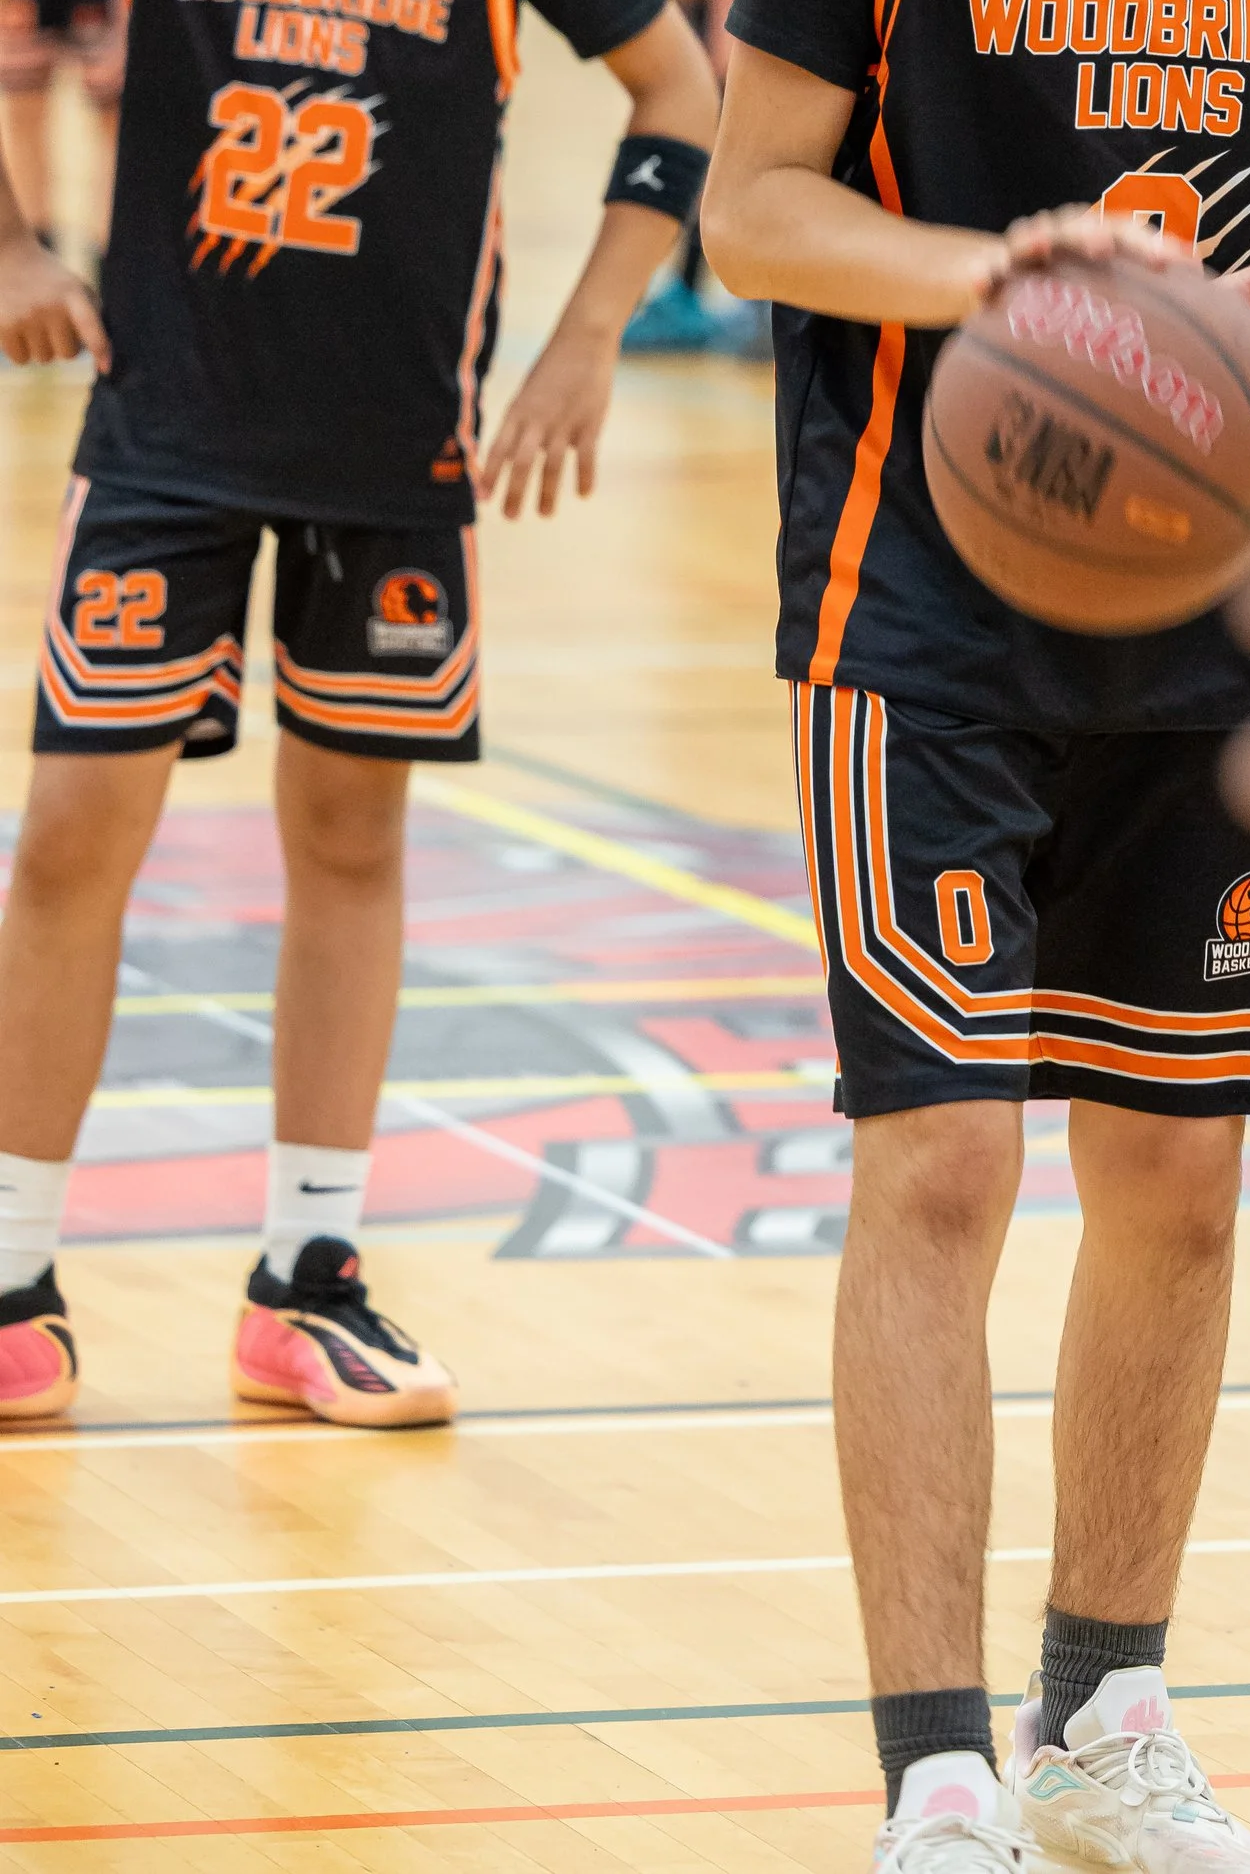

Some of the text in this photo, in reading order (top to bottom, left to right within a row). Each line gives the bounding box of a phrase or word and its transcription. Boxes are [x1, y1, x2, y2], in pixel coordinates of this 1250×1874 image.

[234, 3, 371, 76] LIONS
[1075, 62, 1246, 137] LIONS
[200, 81, 375, 257] 22
[73, 568, 169, 650] 22
[933, 869, 995, 967] 0
